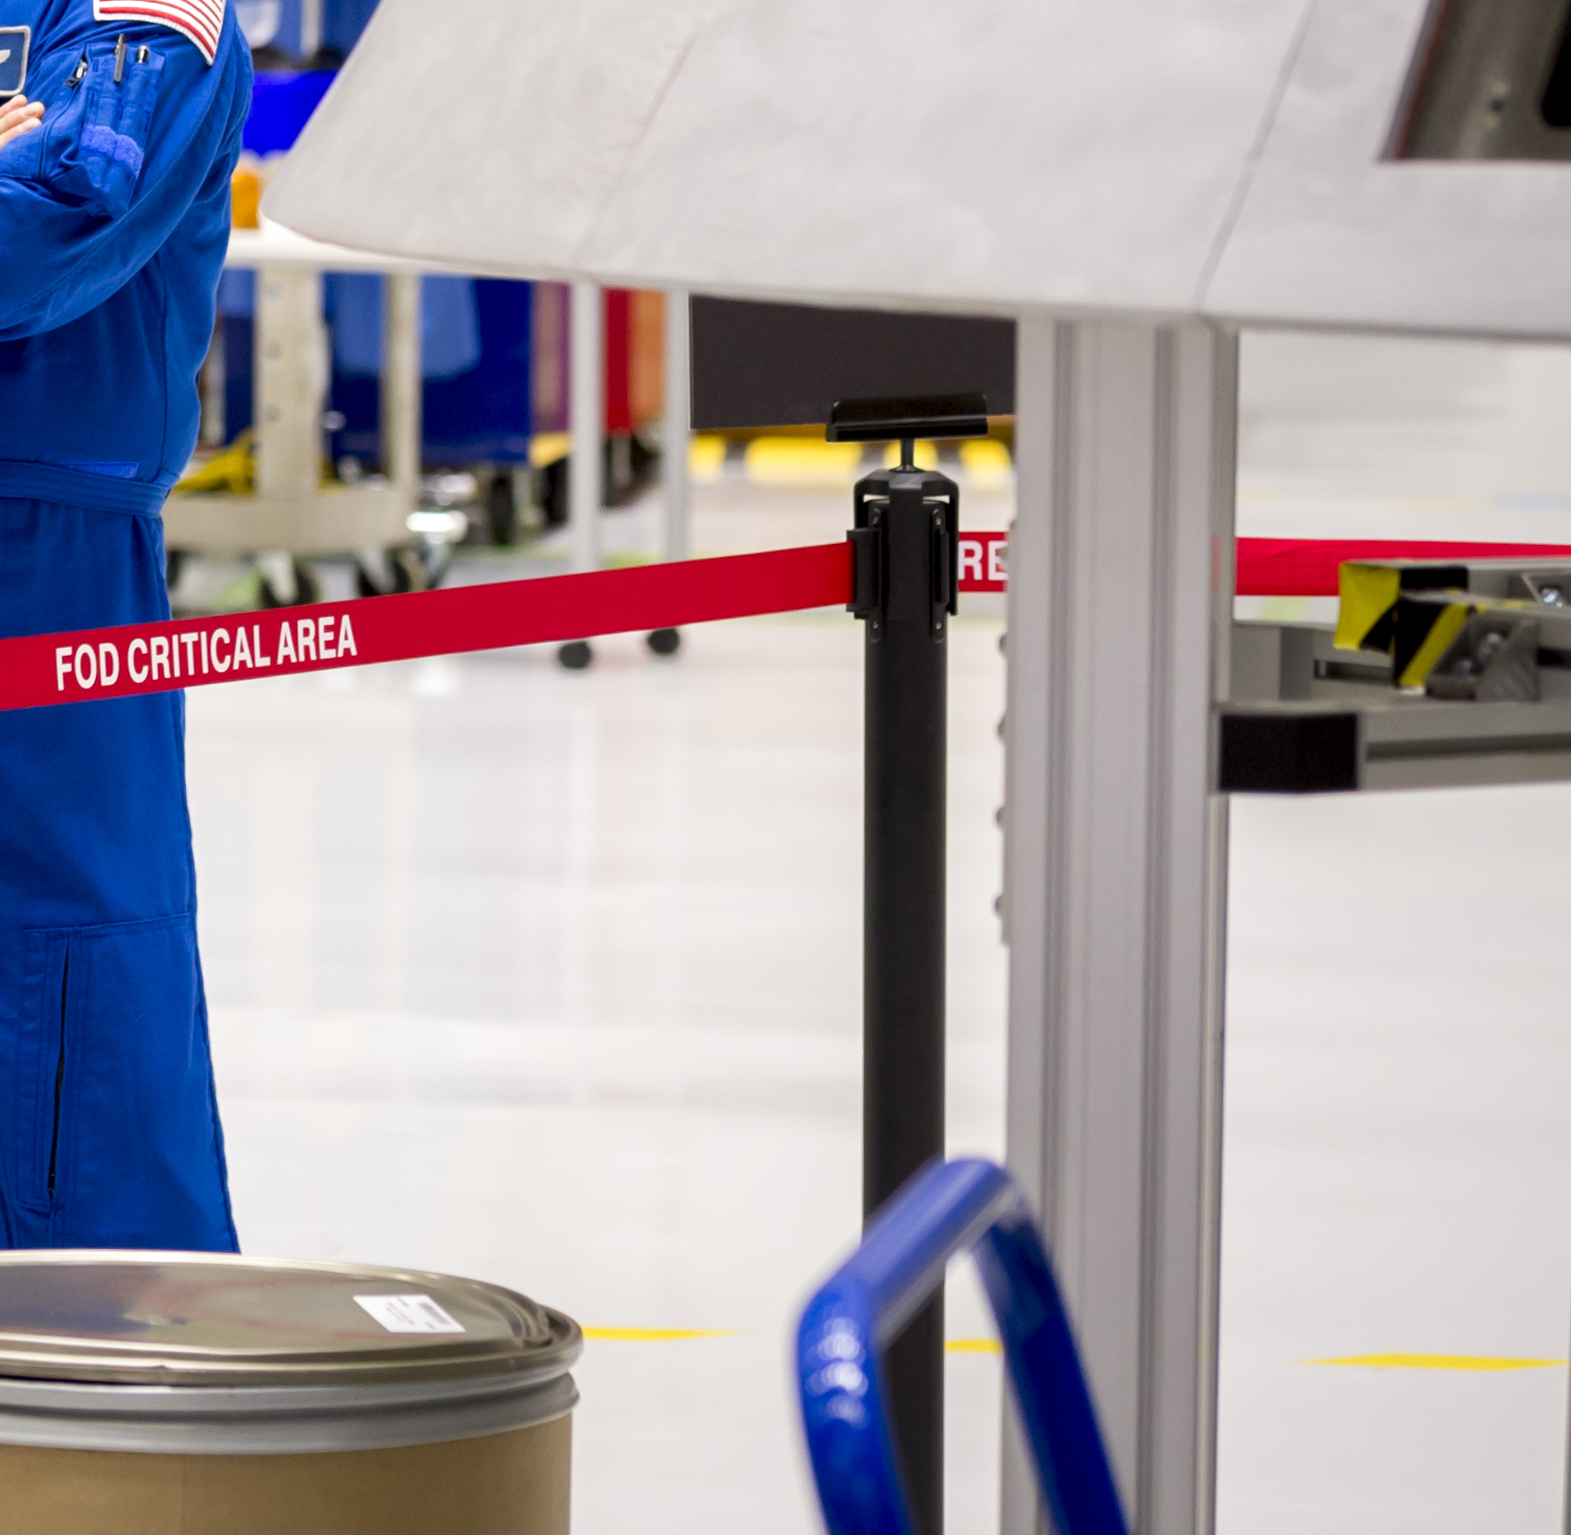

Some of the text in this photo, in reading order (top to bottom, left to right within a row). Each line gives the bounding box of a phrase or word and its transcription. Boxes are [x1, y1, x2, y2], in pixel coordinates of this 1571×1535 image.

[56, 614, 358, 692] FOD CRITICAL AREA
